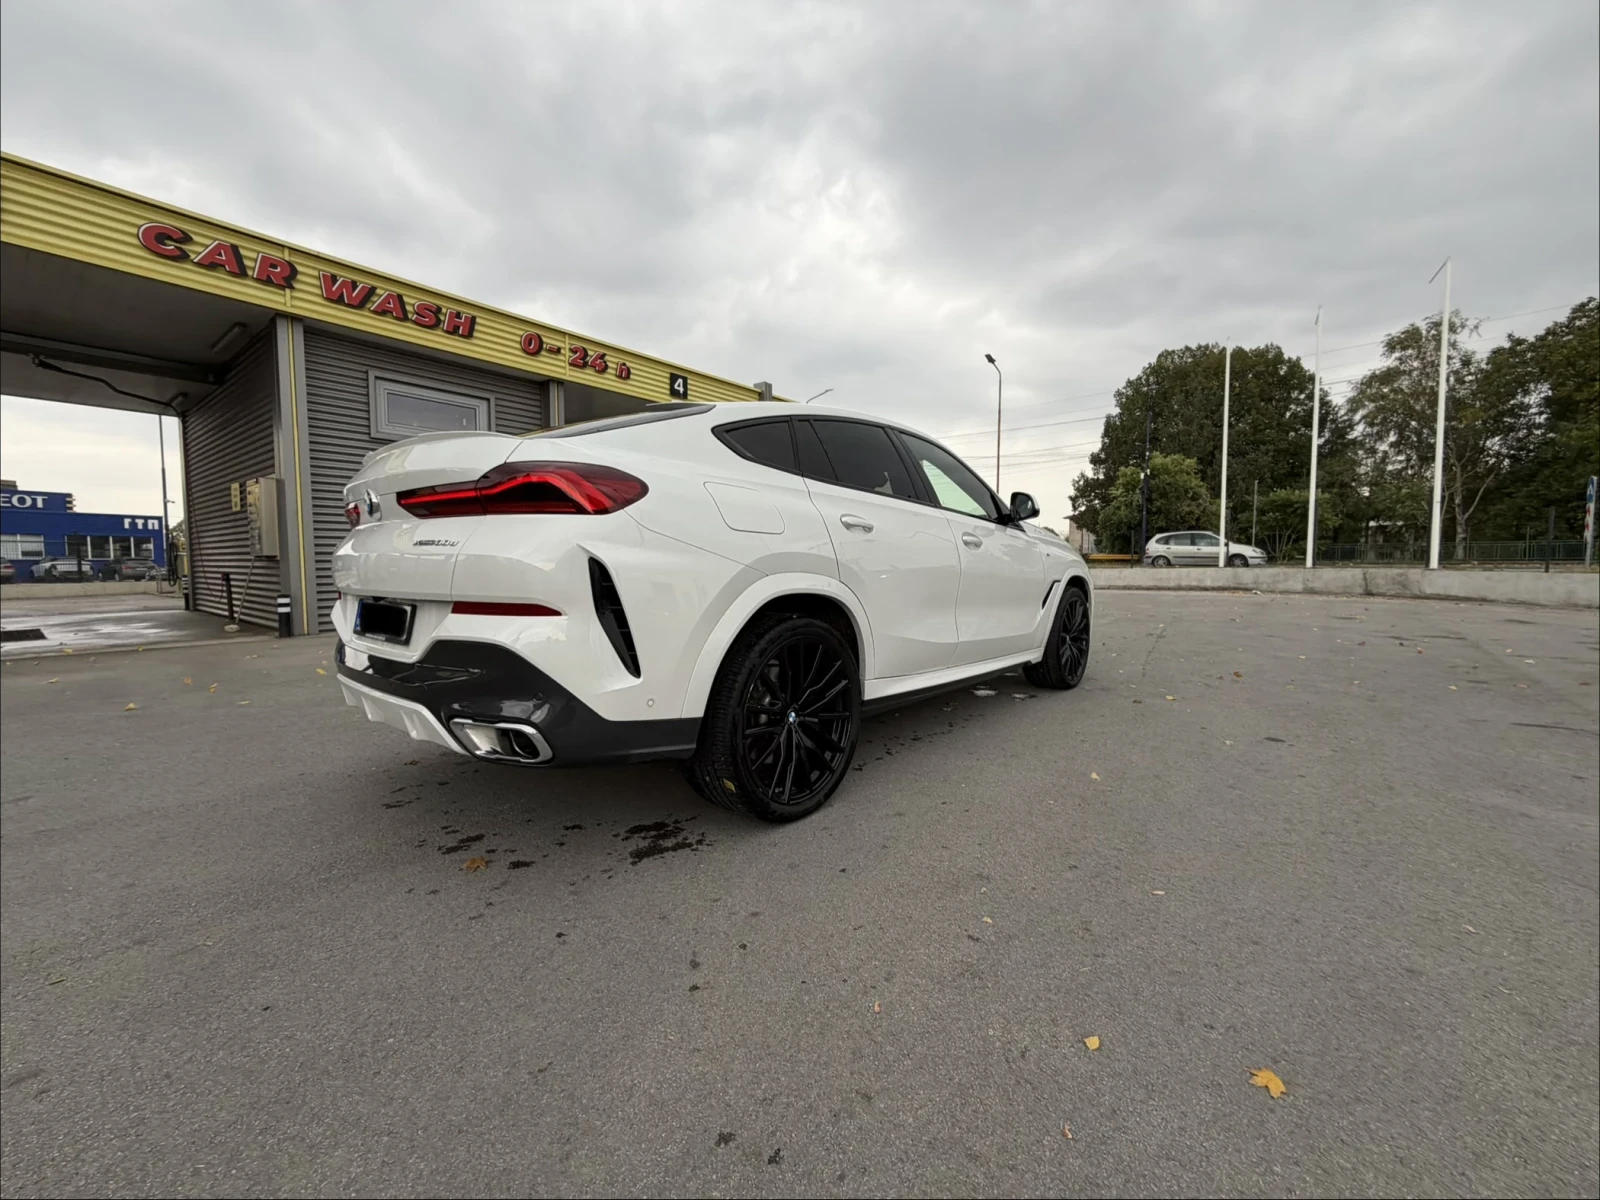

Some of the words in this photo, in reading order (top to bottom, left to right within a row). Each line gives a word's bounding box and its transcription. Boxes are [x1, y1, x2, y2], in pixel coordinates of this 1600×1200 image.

[137, 221, 298, 289] CAR
[319, 270, 477, 340] WASH
[615, 361, 631, 380] h
[674, 378, 684, 393] 4
[0, 493, 48, 508] EOT
[123, 518, 159, 530] ГТП
